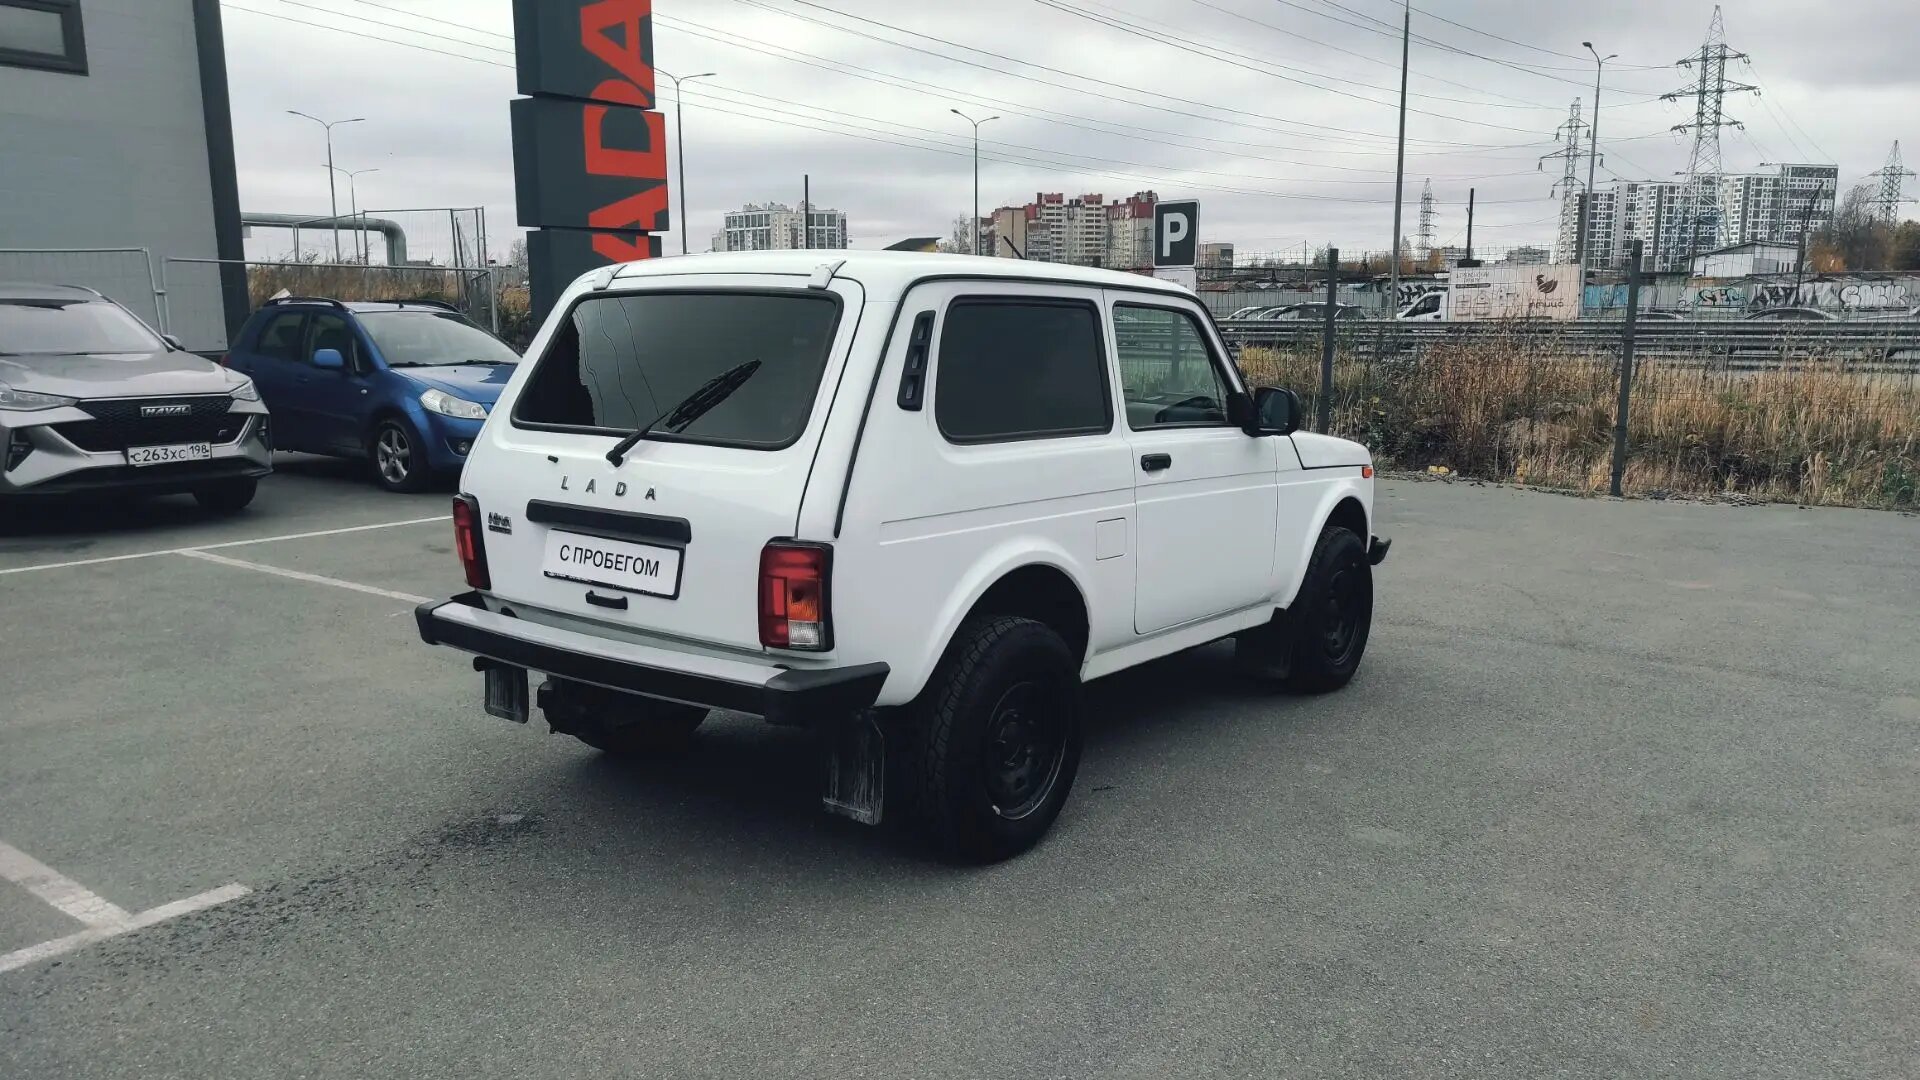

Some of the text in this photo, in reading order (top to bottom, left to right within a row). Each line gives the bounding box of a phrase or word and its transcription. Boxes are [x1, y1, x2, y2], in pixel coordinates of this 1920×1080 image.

[580, 0, 669, 263] ADA
[1163, 212, 1188, 256] P
[145, 406, 189, 415] HAVAL
[189, 445, 207, 455] 198
[561, 475, 656, 501] LADA
[560, 544, 660, 577] С ПРОБЕГОМ
